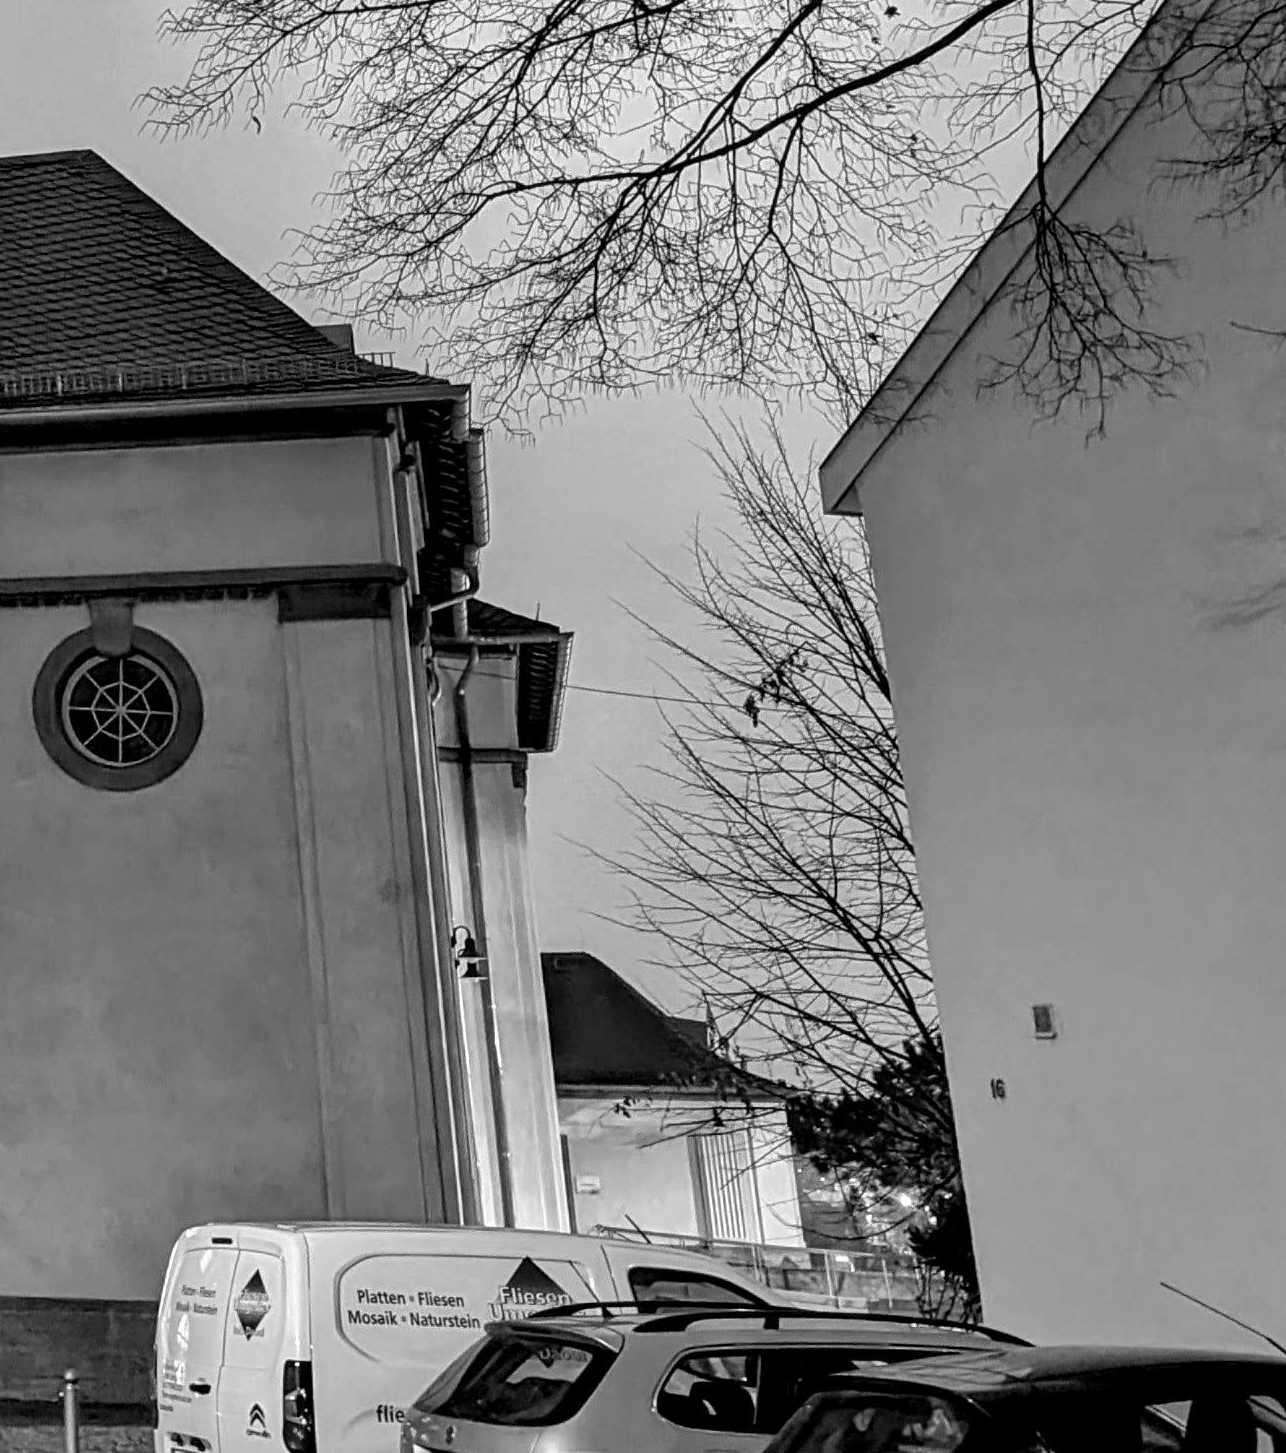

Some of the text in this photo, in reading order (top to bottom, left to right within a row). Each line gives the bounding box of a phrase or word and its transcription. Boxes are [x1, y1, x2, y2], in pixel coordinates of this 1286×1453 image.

[990, 1078, 1005, 1099] 16
[357, 1289, 465, 1308] Platten Fliesen
[499, 1286, 573, 1307] Fliesen
[347, 1310, 481, 1329] Mosaik Naturstein
[377, 1404, 405, 1423] flie
